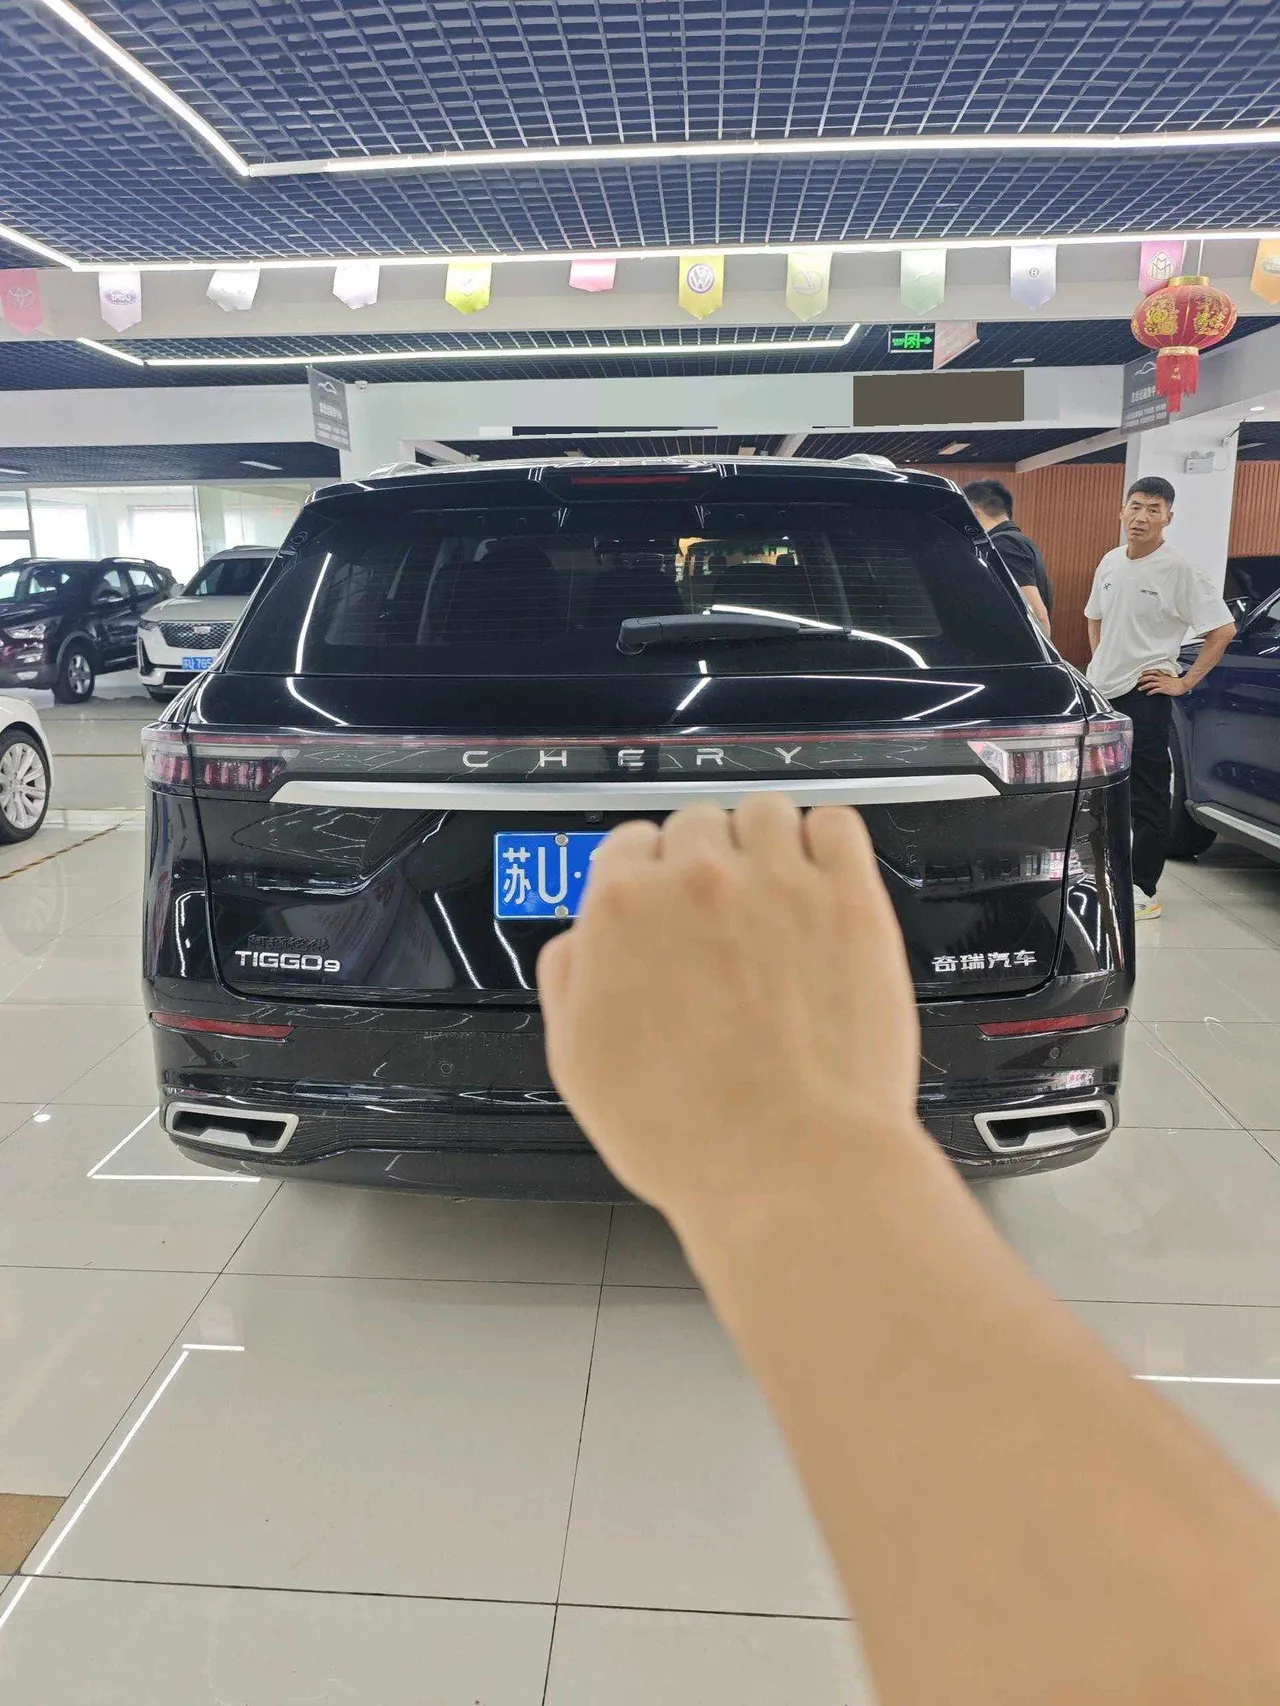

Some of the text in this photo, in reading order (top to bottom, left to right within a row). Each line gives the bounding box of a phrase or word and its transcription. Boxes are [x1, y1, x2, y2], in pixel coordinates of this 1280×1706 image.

[461, 745, 803, 768] CHERY
[502, 846, 604, 905] 苏U·
[931, 949, 1038, 973] 奇瑞汽车
